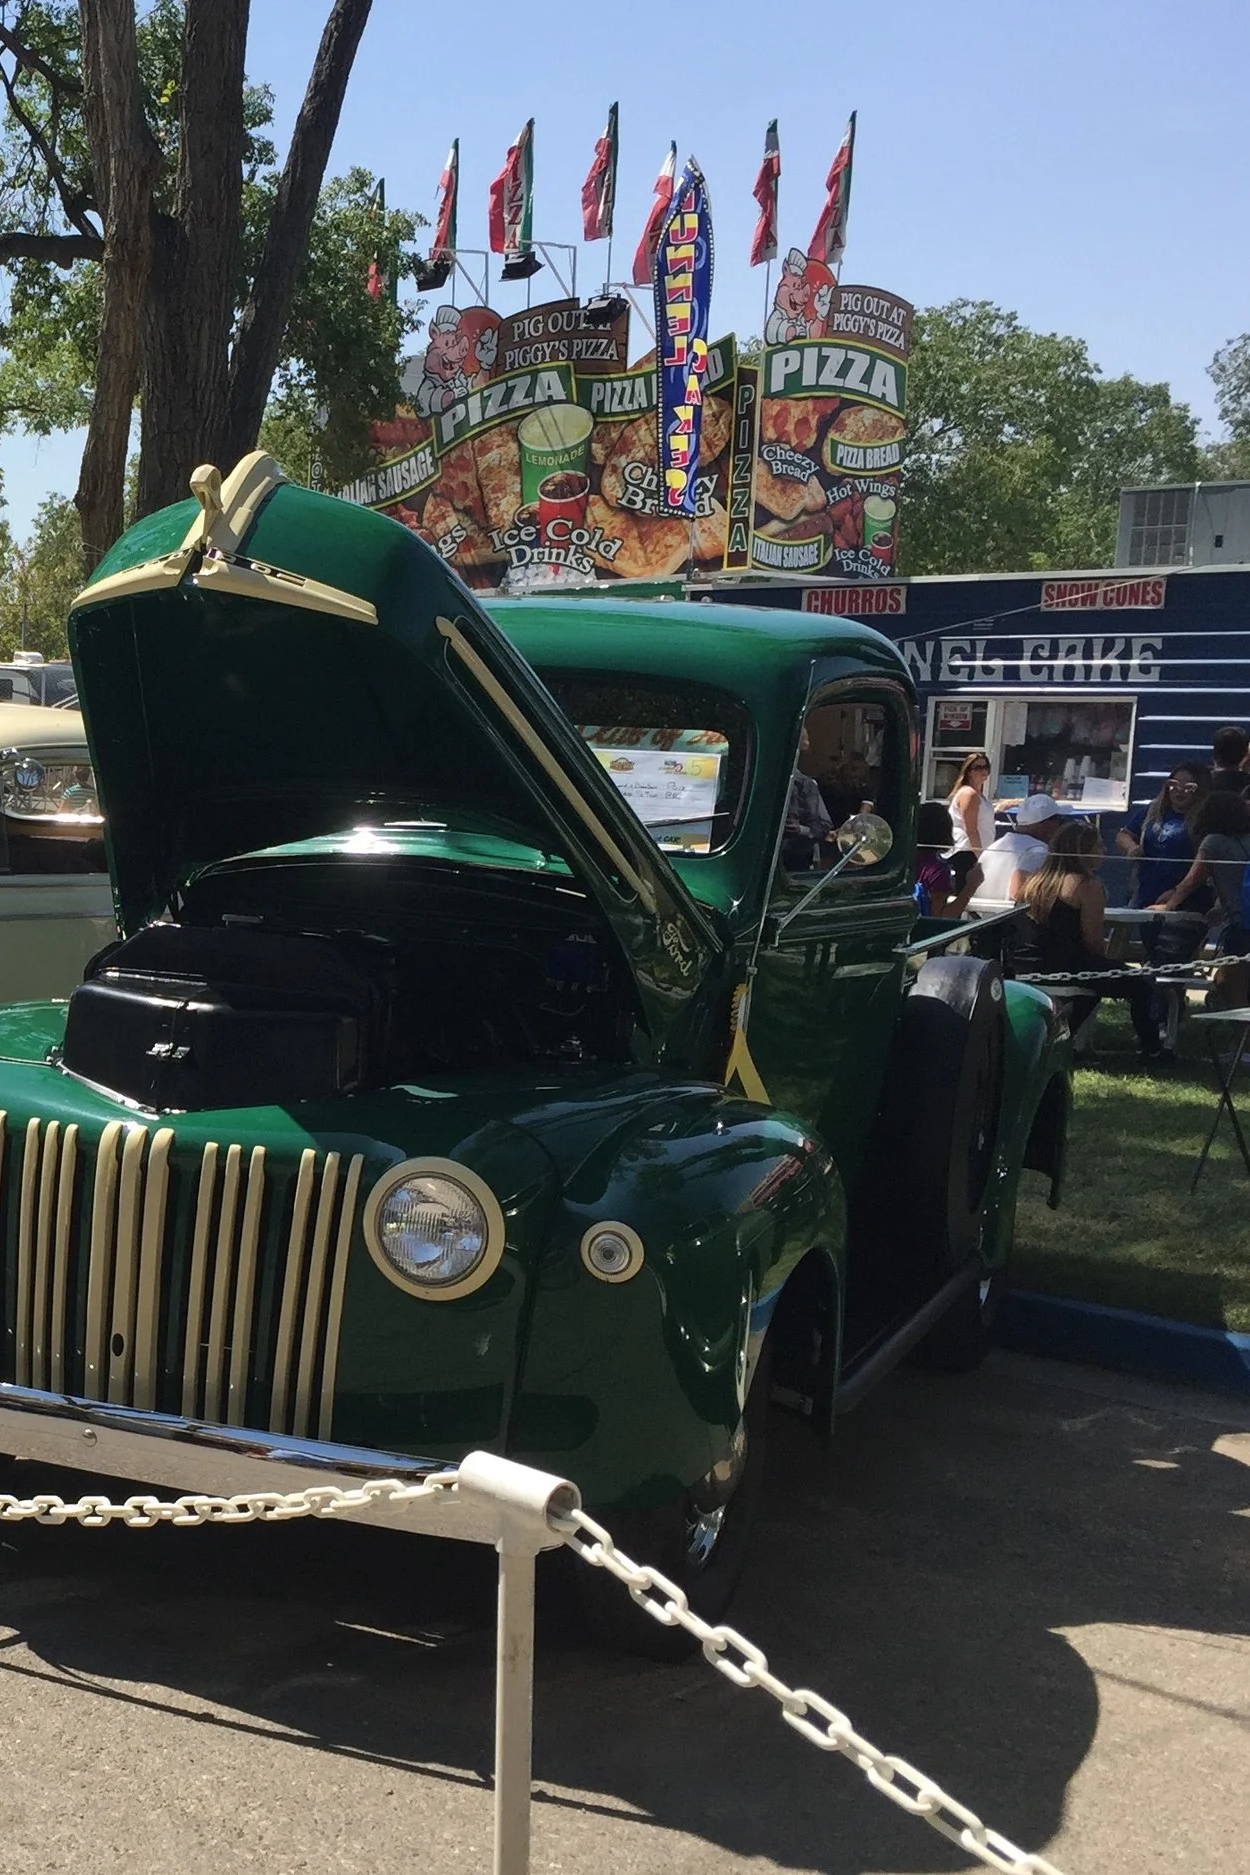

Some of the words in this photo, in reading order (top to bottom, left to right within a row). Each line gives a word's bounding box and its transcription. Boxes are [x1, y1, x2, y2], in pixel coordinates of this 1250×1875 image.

[512, 314, 544, 342] PIG
[547, 309, 590, 333] OUT
[840, 292, 862, 312] PIG
[863, 295, 890, 319] OUT
[890, 307, 907, 327] AT
[833, 313, 875, 337] PIGGY'S
[877, 323, 906, 350] PIZZA
[504, 340, 569, 371] PIGGY'S
[571, 339, 619, 360] PIZZA
[770, 346, 899, 408] PIZZA
[440, 370, 567, 444] PIZZA
[591, 374, 648, 414] PIZZA
[525, 446, 586, 466] LEMONADE
[729, 384, 756, 553] PIZZA
[762, 446, 820, 475] Cheezy
[835, 444, 864, 469] PIZZA
[865, 442, 901, 469] BREAD
[378, 446, 435, 499] SAUSAGE
[771, 461, 810, 483] Bread
[617, 484, 715, 517] Brd
[826, 483, 853, 505] Hot
[855, 479, 897, 498] Wings
[488, 525, 537, 552] Ice
[546, 518, 624, 561] Cold
[753, 536, 782, 567] ITALIAN
[783, 541, 819, 568] SAUSAGE
[508, 544, 596, 574] Drinks
[834, 548, 856, 561] Ice
[858, 550, 891, 577] Cold
[842, 559, 880, 579] Drinks
[806, 587, 902, 614] CHURROS
[1043, 580, 1099, 609] SNOW
[1102, 578, 1164, 607] CONES
[902, 640, 1005, 682] NEL
[1019, 638, 1164, 682] CAKE
[662, 922, 693, 977] Ford
